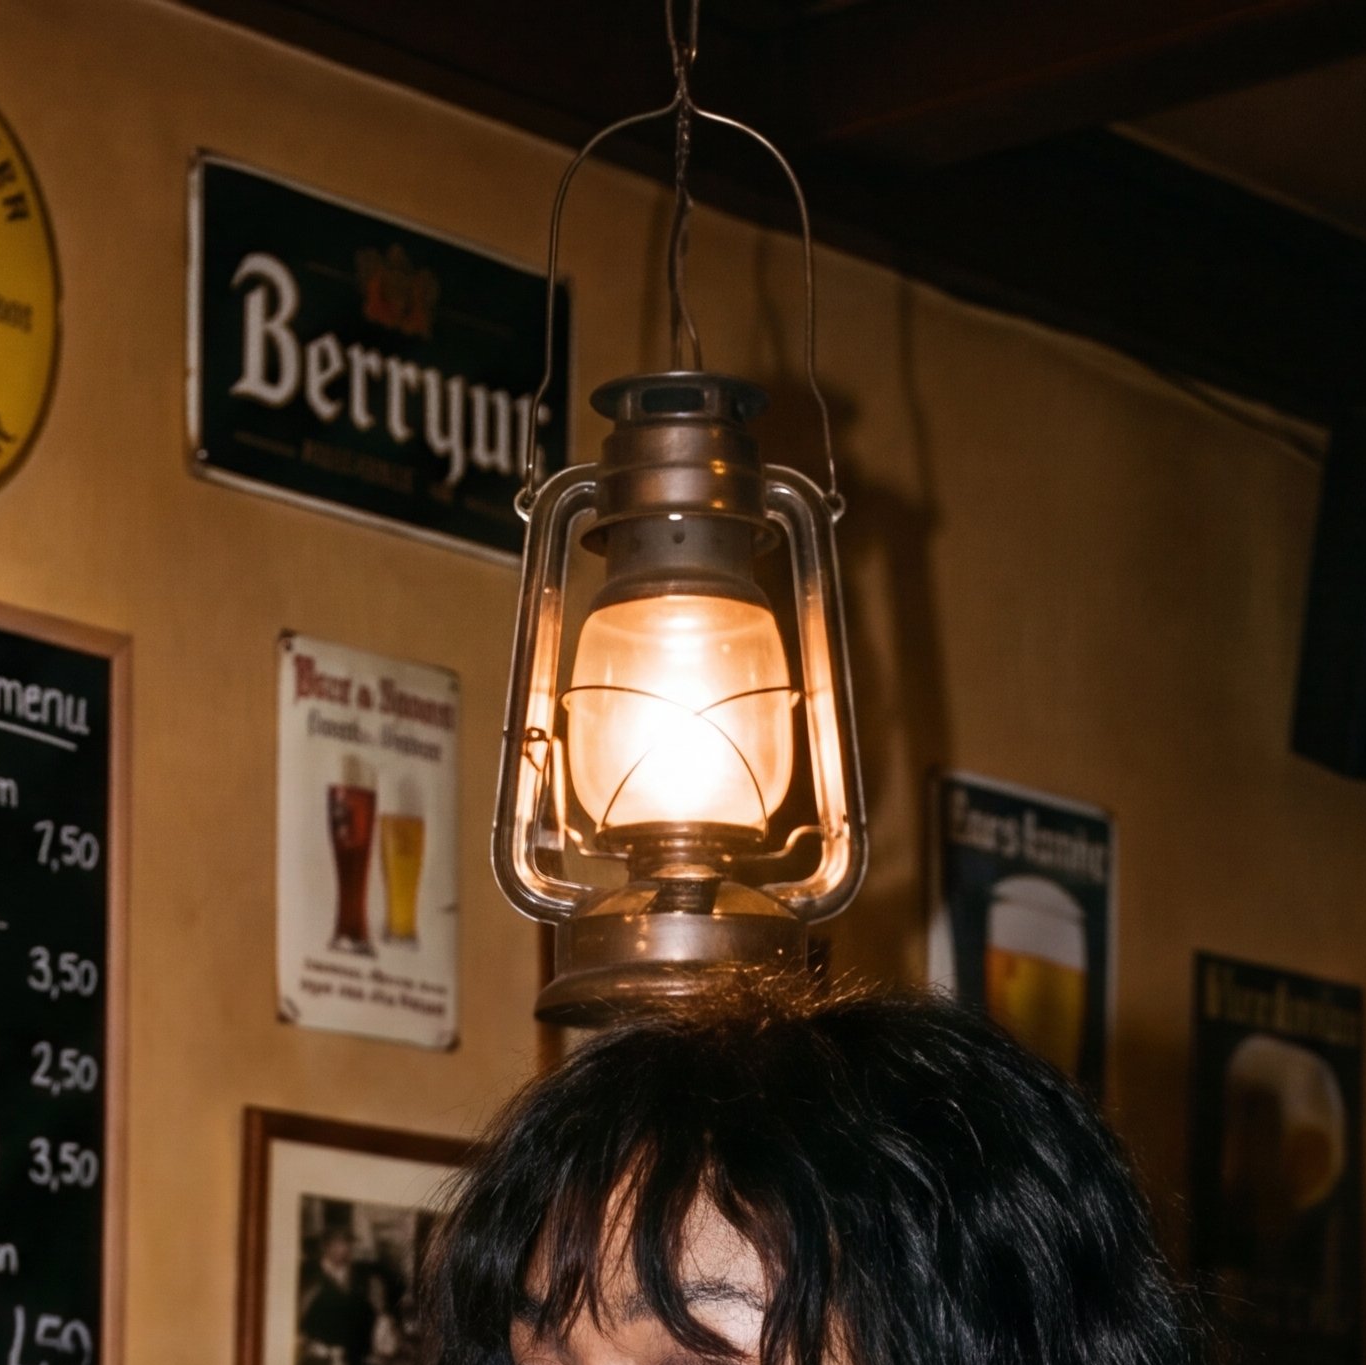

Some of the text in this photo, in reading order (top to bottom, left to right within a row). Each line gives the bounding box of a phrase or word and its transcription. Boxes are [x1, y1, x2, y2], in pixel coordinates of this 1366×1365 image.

[27, 945, 100, 1000] 3,50
[30, 1040, 100, 1096] 2,50
[27, 1135, 100, 1193] 3,50
